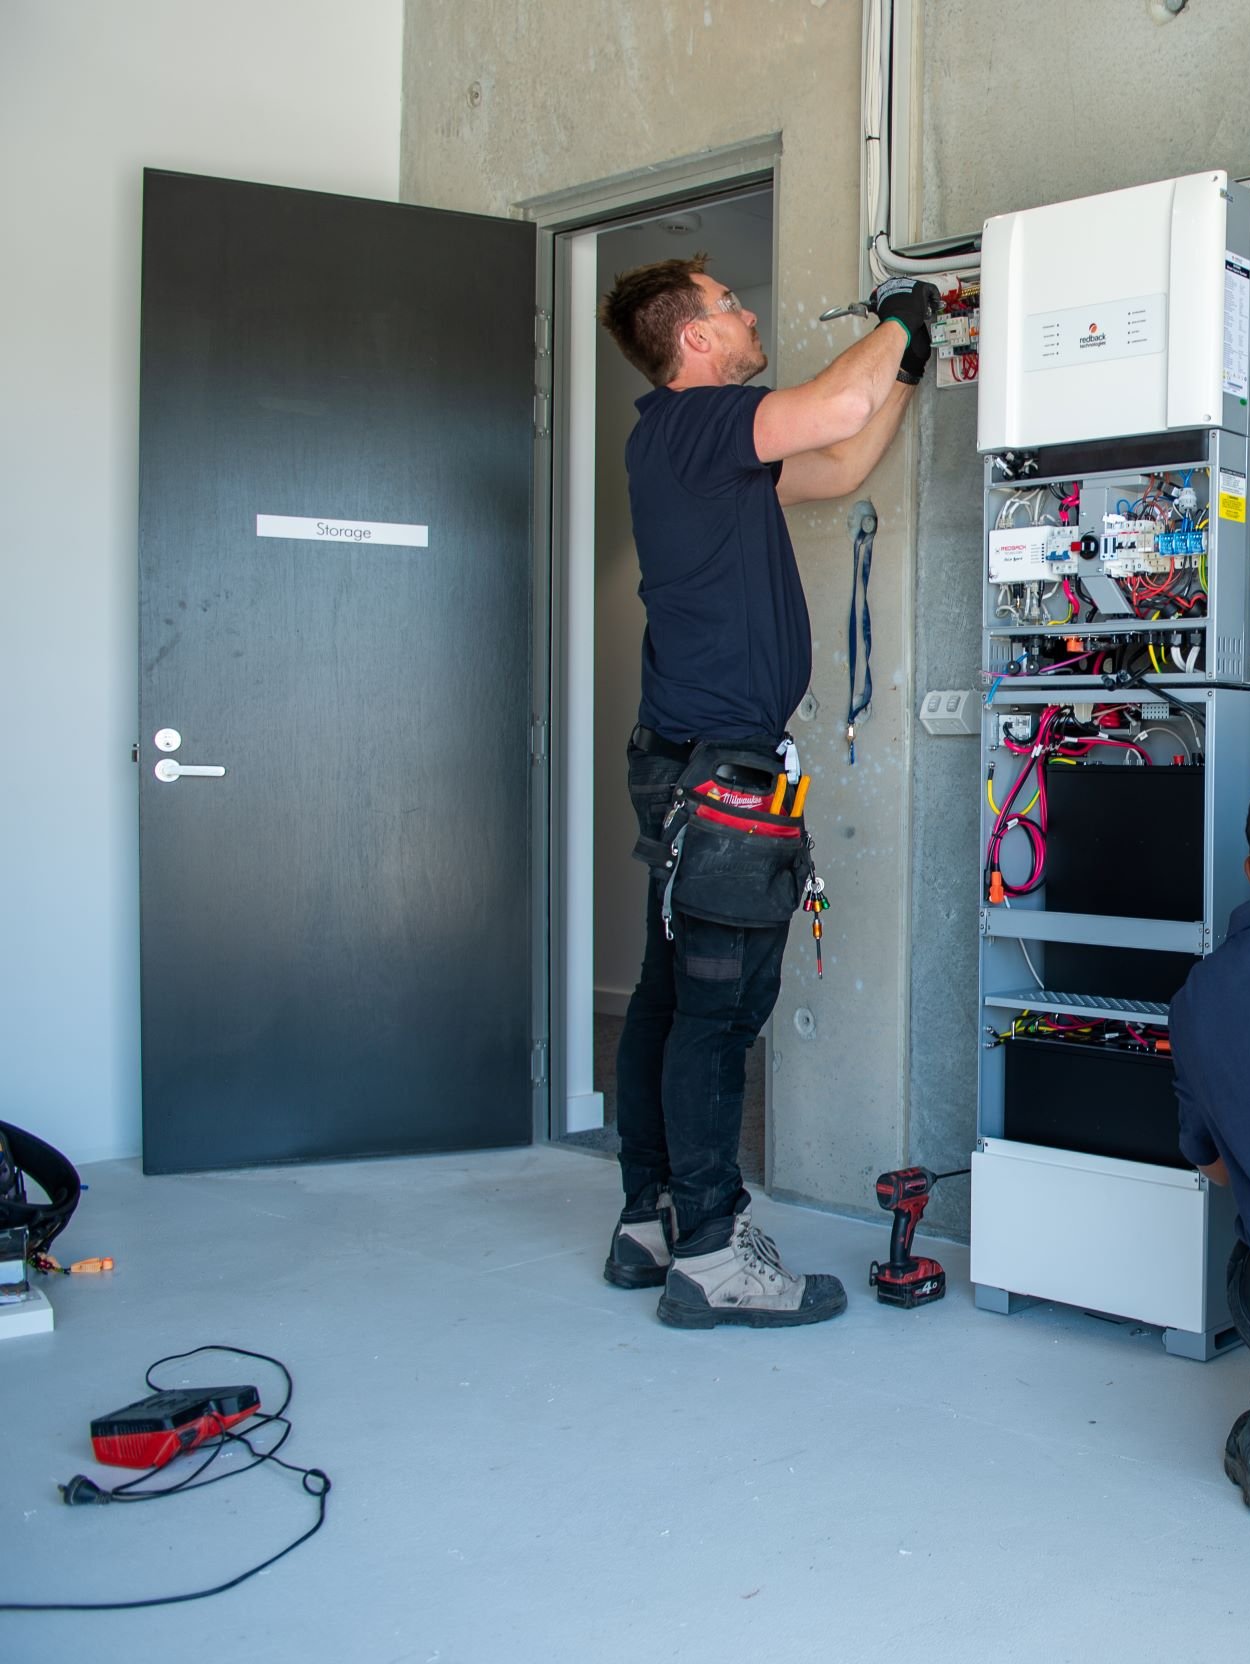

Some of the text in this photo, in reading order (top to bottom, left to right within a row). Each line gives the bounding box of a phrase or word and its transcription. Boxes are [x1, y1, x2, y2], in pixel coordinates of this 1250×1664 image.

[1079, 333, 1106, 344] redback
[316, 521, 372, 542] Storage
[720, 792, 762, 807] Milwaukee
[922, 1281, 938, 1295] 4.0
